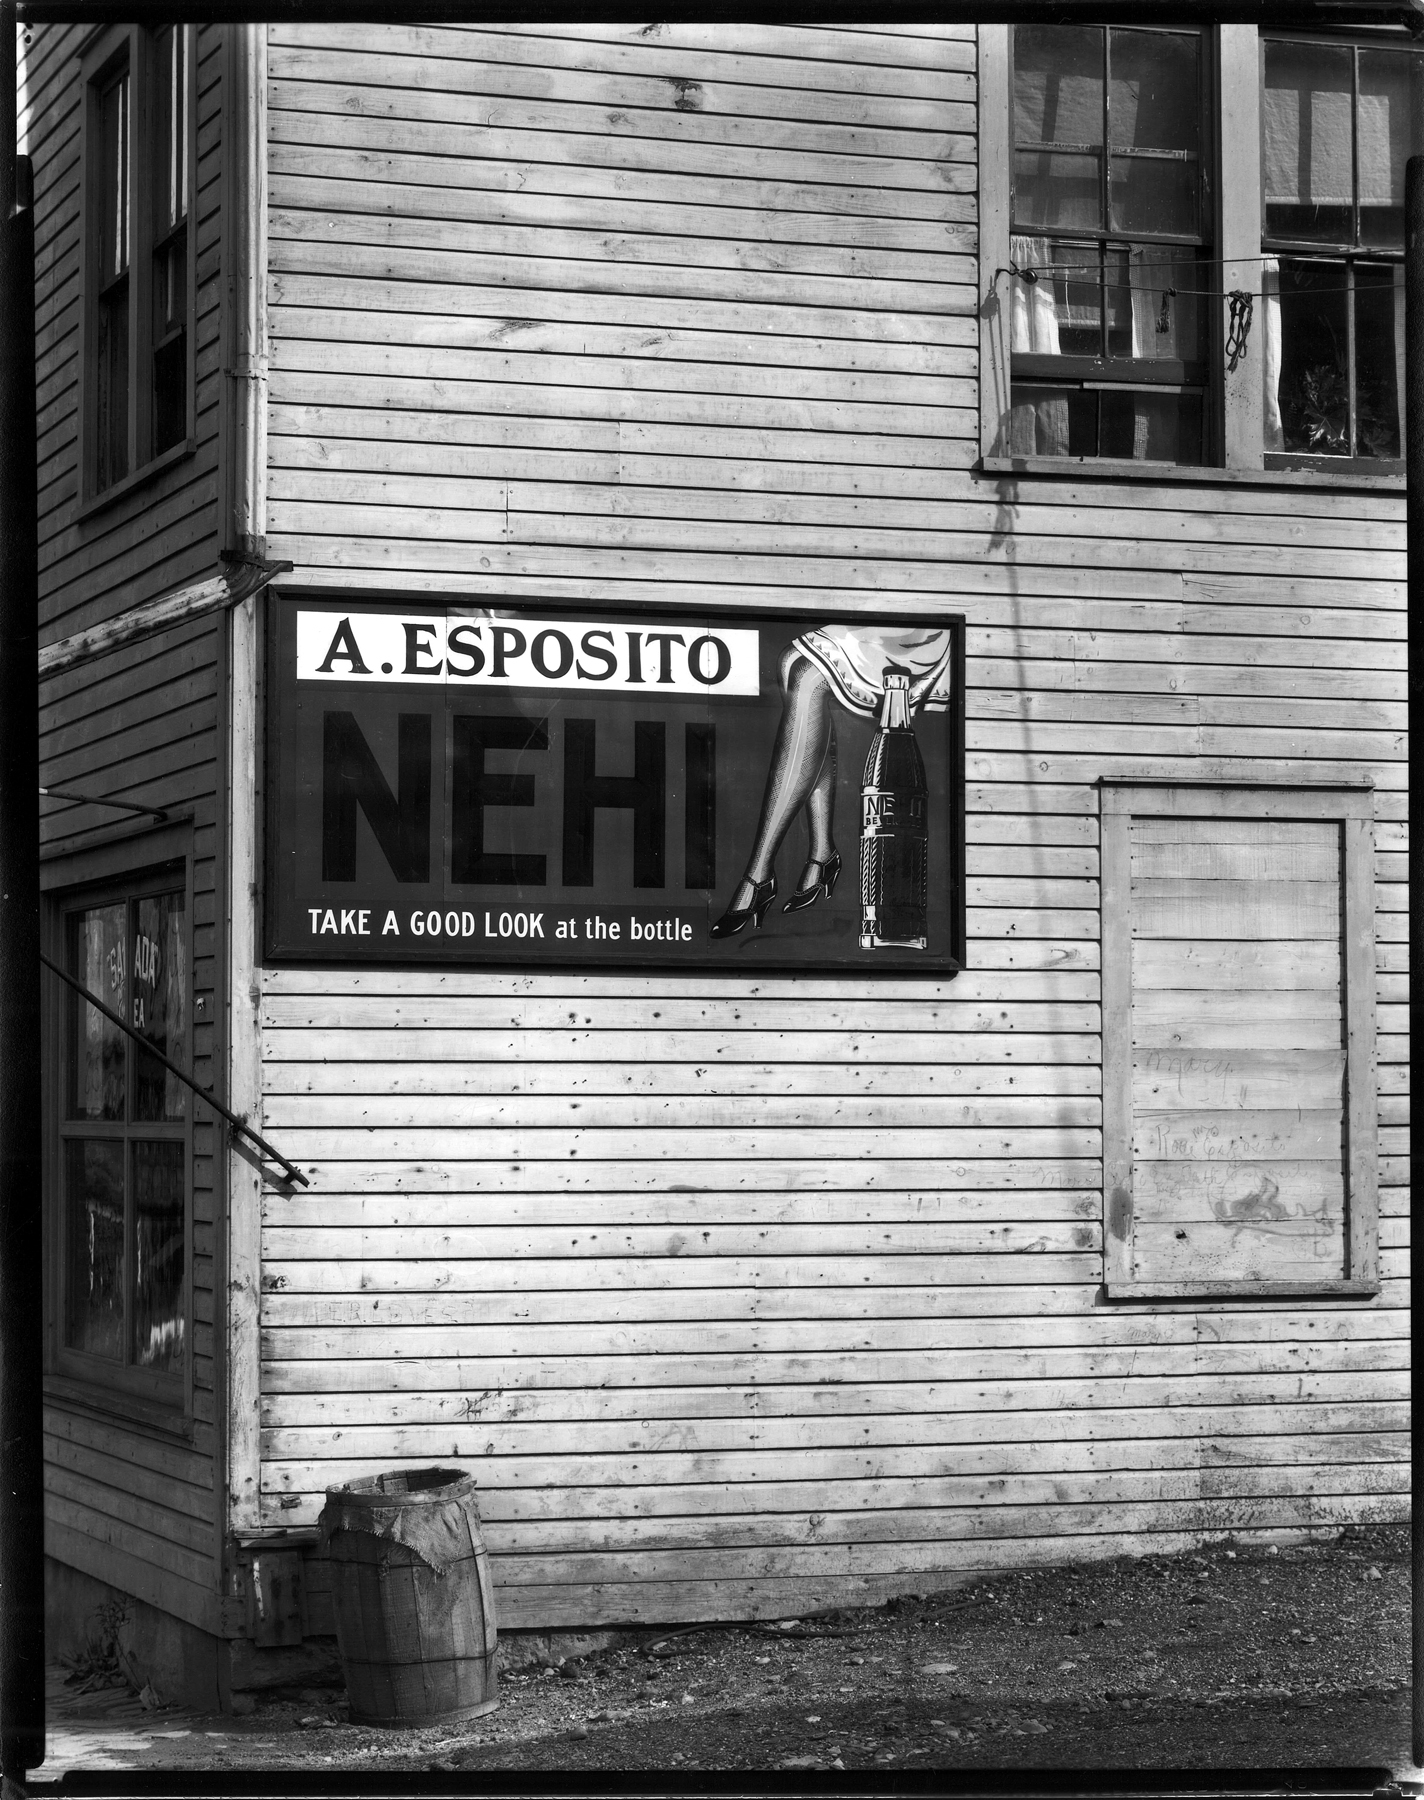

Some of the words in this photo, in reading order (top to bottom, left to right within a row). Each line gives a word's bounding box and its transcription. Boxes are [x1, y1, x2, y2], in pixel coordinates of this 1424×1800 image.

[322, 711, 716, 889] NEHI
[307, 908, 372, 935] TAKE
[381, 910, 400, 936] A
[410, 910, 475, 937] GOOD
[485, 911, 545, 938] LOOK
[555, 917, 579, 939] at
[584, 915, 621, 940] the
[630, 915, 693, 942] bottle
